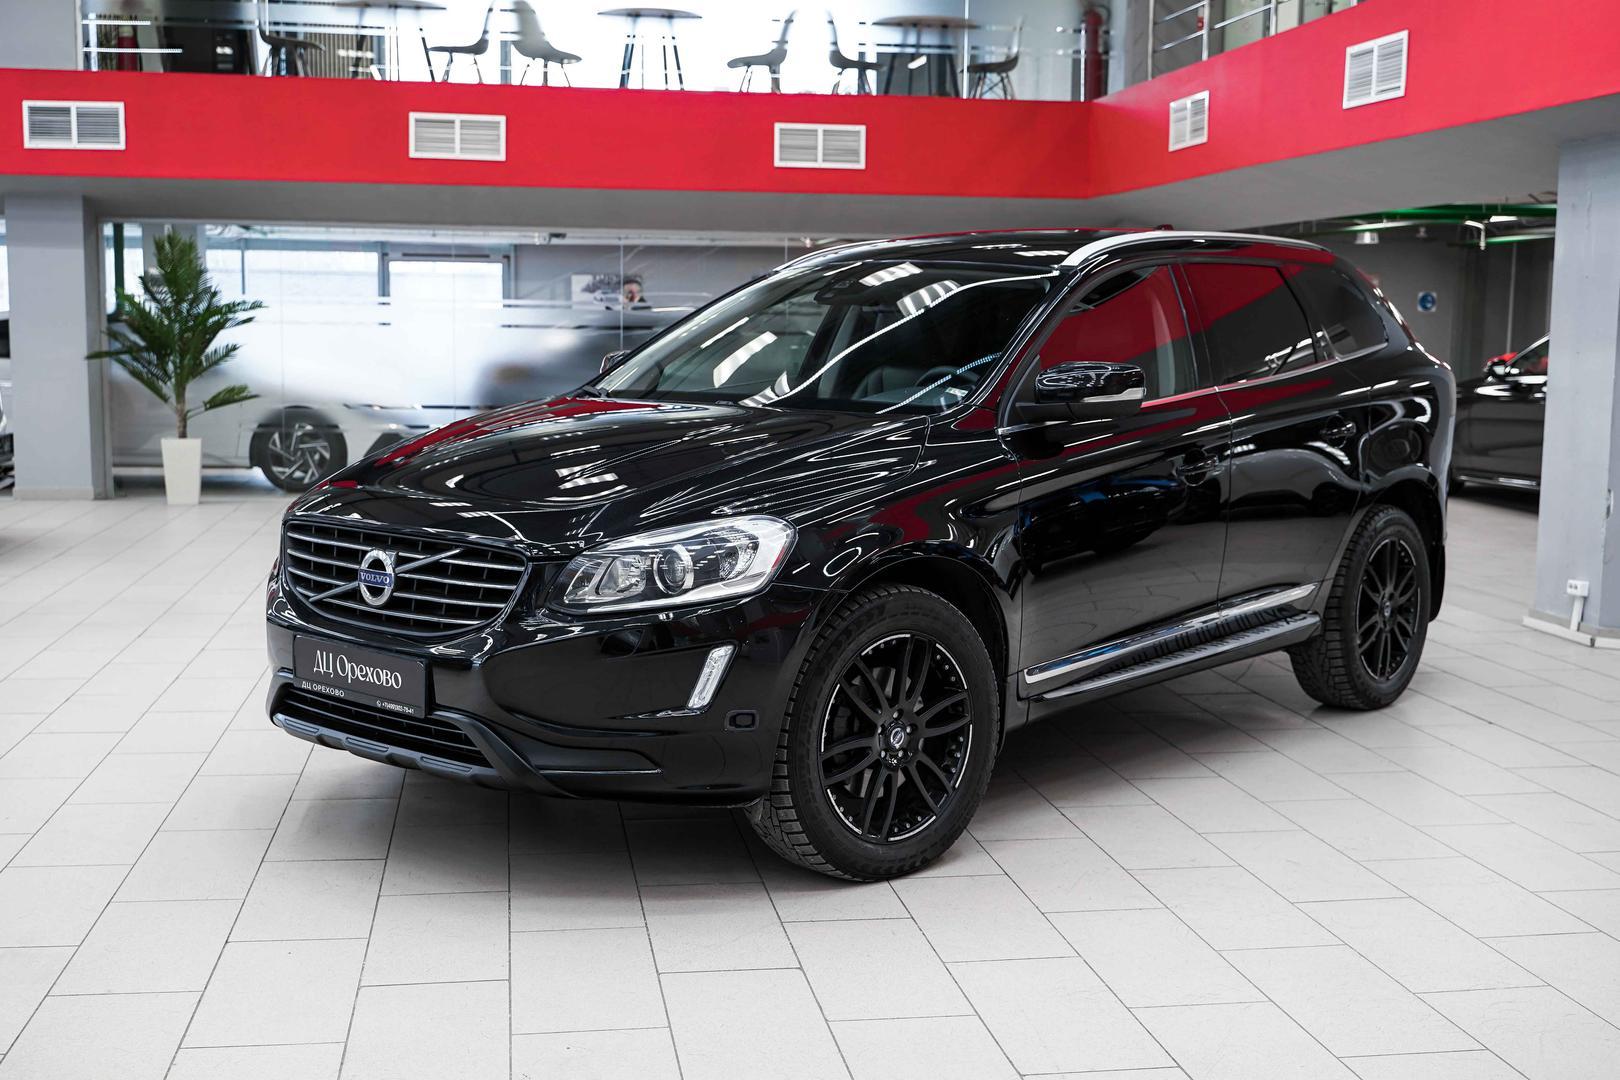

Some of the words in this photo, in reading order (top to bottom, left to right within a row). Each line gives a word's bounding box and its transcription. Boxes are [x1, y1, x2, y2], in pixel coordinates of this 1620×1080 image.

[360, 572, 390, 584] VOLVO
[314, 649, 333, 678] ДЦ
[336, 654, 402, 690] Орехово
[301, 680, 312, 691] ДЦ
[312, 683, 345, 698] ОРЕХОВО
